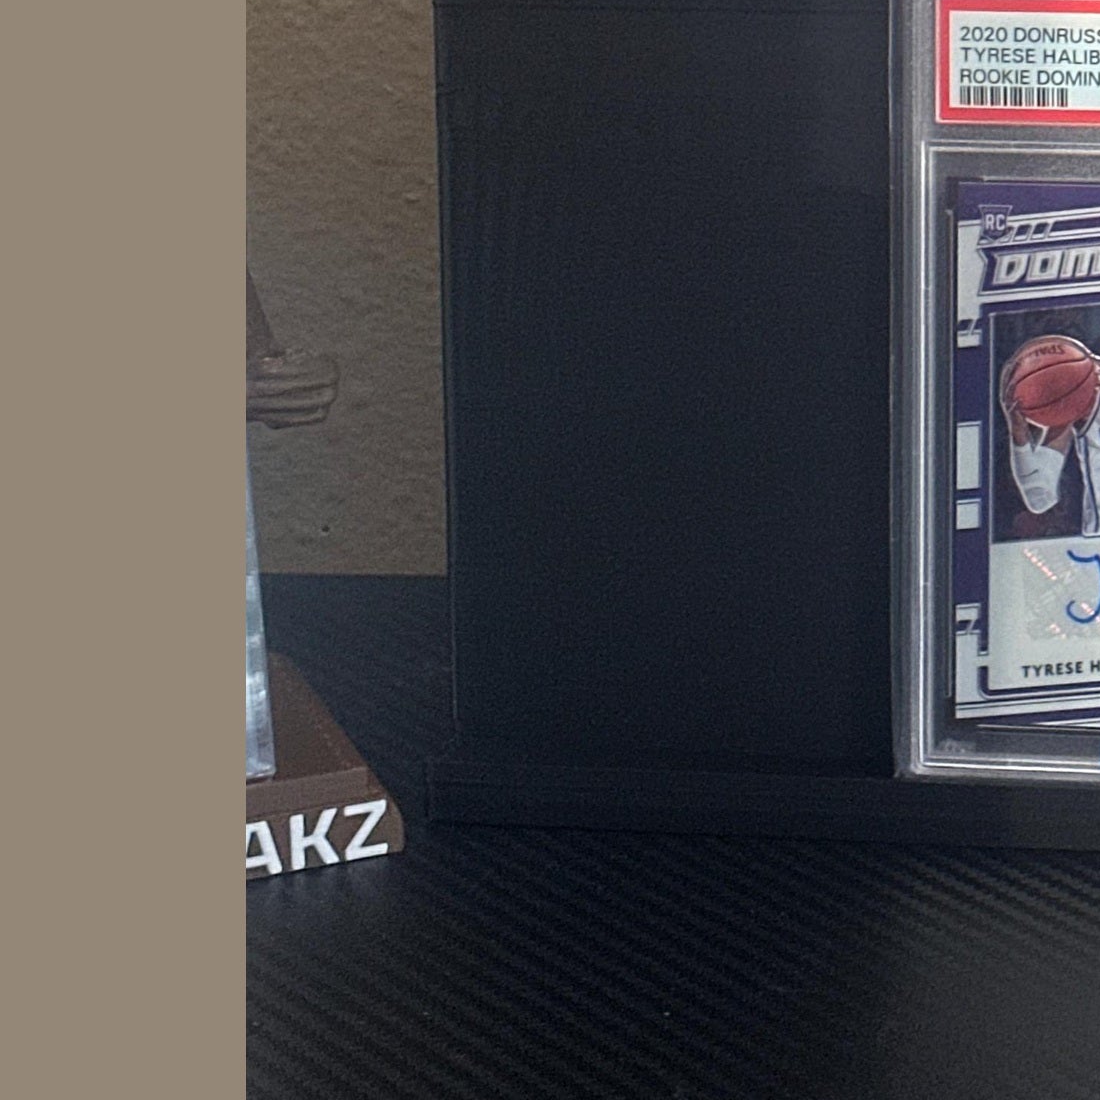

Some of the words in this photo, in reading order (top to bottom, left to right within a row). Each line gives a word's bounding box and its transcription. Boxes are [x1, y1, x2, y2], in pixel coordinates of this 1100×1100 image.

[960, 26, 1008, 43] 2020
[959, 47, 1036, 64] TYRESE
[960, 69, 1030, 85] ROOKIE
[985, 213, 1005, 231] RC
[1021, 660, 1083, 678] TYRESE
